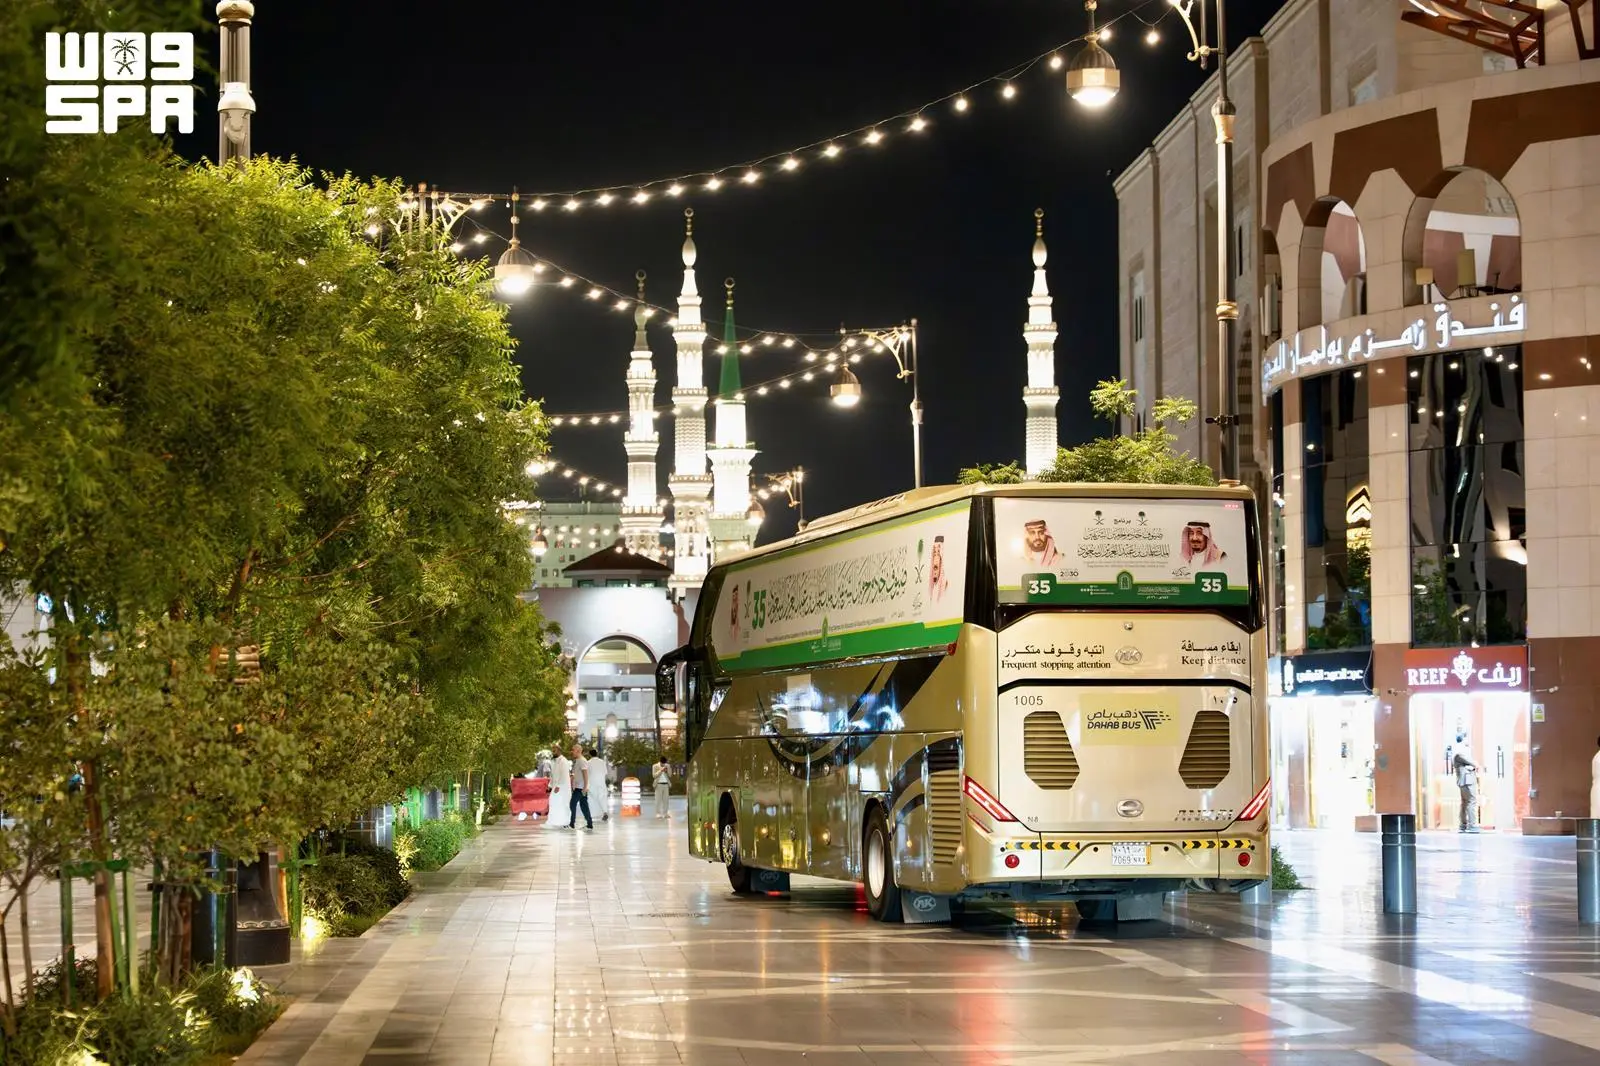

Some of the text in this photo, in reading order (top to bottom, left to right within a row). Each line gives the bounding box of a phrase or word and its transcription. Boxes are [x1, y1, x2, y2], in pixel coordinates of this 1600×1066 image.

[1433, 295, 1526, 348] فندق
[1349, 318, 1426, 361] زمزم
[1113, 517, 1132, 526] برنامج
[1028, 580, 1051, 595] 35
[1201, 578, 1222, 593] 35
[751, 588, 767, 630] 35
[1003, 643, 1105, 659] انتبه وقوف متكرر
[1181, 639, 1218, 652] مسافة
[1001, 659, 1111, 671] Frequent stopping attention
[1181, 656, 1206, 668] Keep
[1407, 667, 1449, 686] REEF
[1477, 662, 1522, 687] ريف
[1013, 695, 1043, 706] 1005
[1087, 708, 1112, 720] باص
[1087, 720, 1142, 730] DAHAB BUS
[1113, 856, 1132, 865] 7069
